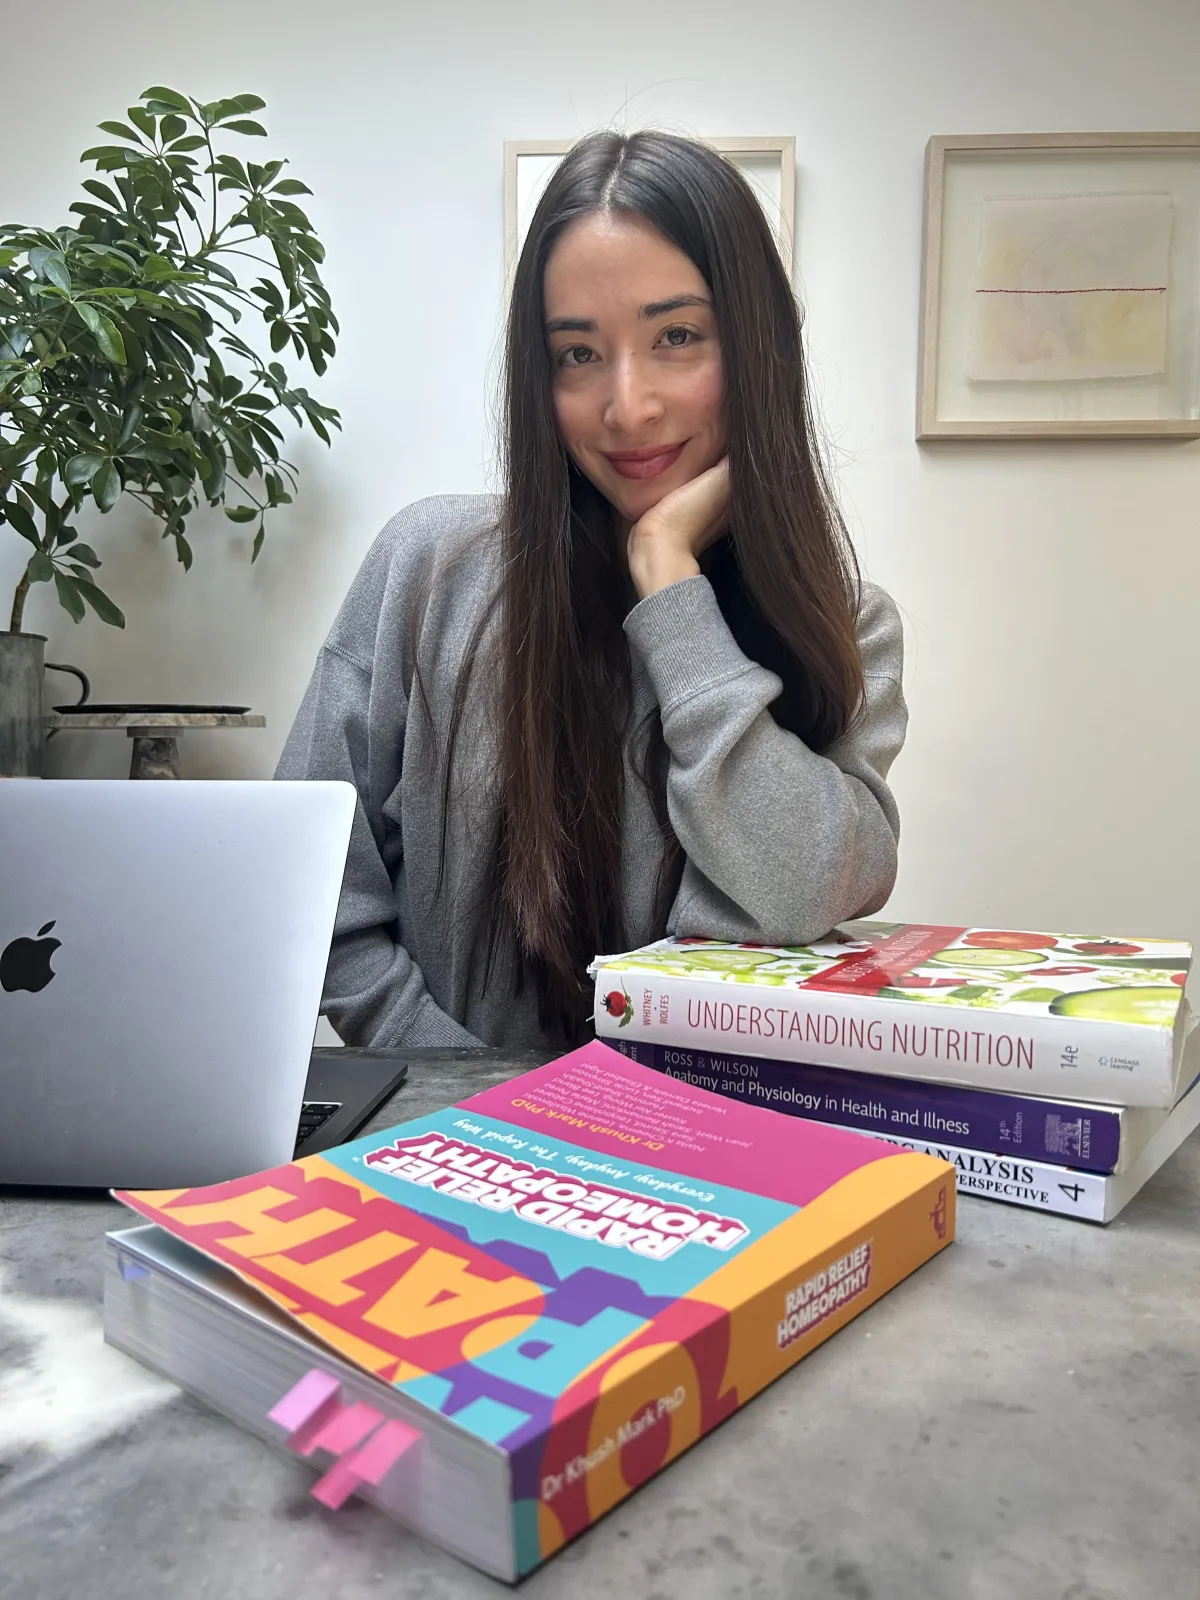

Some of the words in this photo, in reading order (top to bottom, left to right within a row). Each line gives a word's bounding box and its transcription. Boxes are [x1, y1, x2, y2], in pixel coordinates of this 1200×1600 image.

[643, 988, 653, 1026] WHITNEY
[659, 994, 669, 1025] ROLFES
[688, 999, 882, 1051] UNDERSTANDING
[892, 1022, 1034, 1070] NUTRITION
[664, 1050, 693, 1068] ROSS
[697, 1056, 707, 1068] &
[711, 1057, 760, 1079] WILSON
[1060, 1045, 1079, 1069] 14e
[511, 1097, 545, 1114] PhD
[664, 1067, 719, 1092] Anatomy
[722, 1077, 745, 1094] and
[749, 1081, 822, 1111] Physiology
[825, 1093, 838, 1110] in
[842, 1099, 887, 1121] Health
[891, 1109, 919, 1126] and
[924, 1112, 970, 1135] Illness
[452, 1118, 485, 1136] Way
[546, 1109, 588, 1128] Mark
[590, 1123, 641, 1145] Khush
[999, 1120, 1012, 1141] 14th
[1013, 1111, 1023, 1144] Edition
[484, 1129, 528, 1152] Rapid
[529, 1144, 560, 1161] The
[642, 1141, 665, 1151] Dr
[1082, 1118, 1092, 1159] ELSEVIER
[368, 1152, 523, 1213] RELIEF
[397, 1134, 746, 1250] HOMEOPATHY
[955, 1173, 1050, 1204] ERSPECTIVE
[1057, 1182, 1086, 1203] 4
[518, 1199, 685, 1261] RAPID
[786, 1271, 828, 1316] RAPID
[828, 1241, 870, 1286] RELIEF
[777, 1263, 870, 1348] HOMEOPATHY
[541, 1473, 564, 1501] Dr
[616, 1407, 656, 1445] Mark
[656, 1385, 687, 1419] PhD
